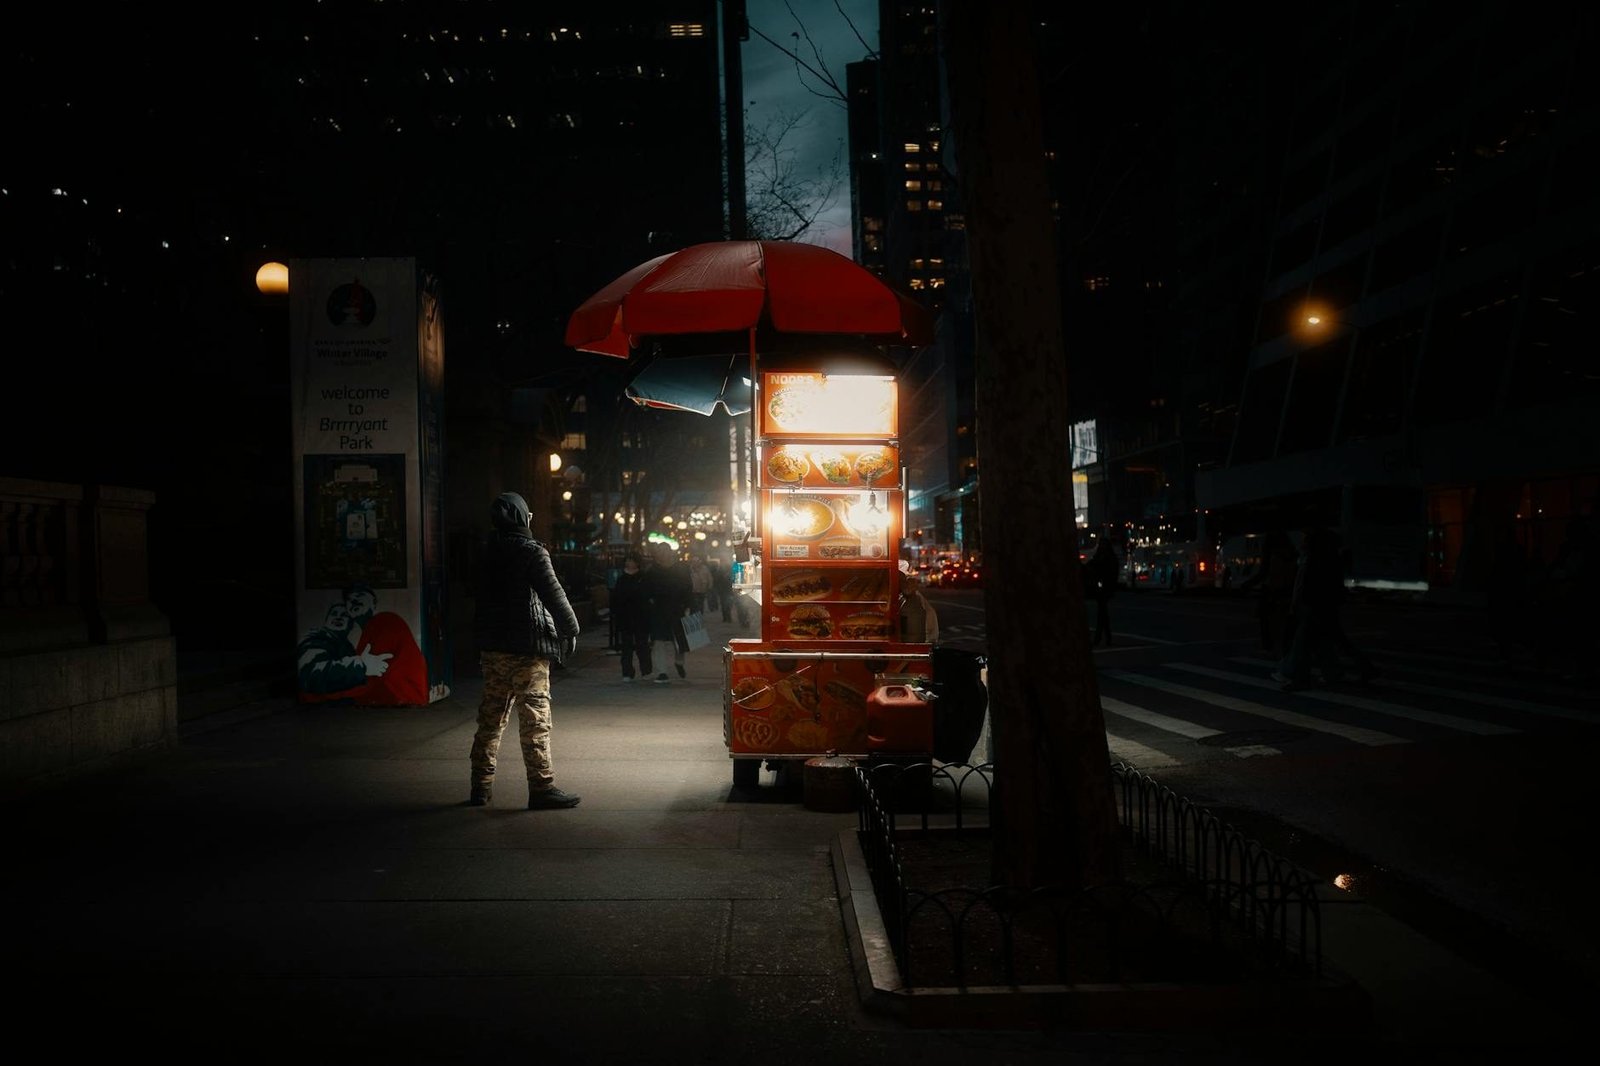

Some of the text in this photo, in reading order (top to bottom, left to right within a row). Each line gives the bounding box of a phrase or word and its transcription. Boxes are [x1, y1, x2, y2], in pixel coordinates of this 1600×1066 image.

[353, 347, 388, 360] Village
[321, 385, 390, 400] welcome
[348, 403, 364, 416] to
[319, 417, 388, 434] Brrrryant
[339, 435, 373, 450] Park
